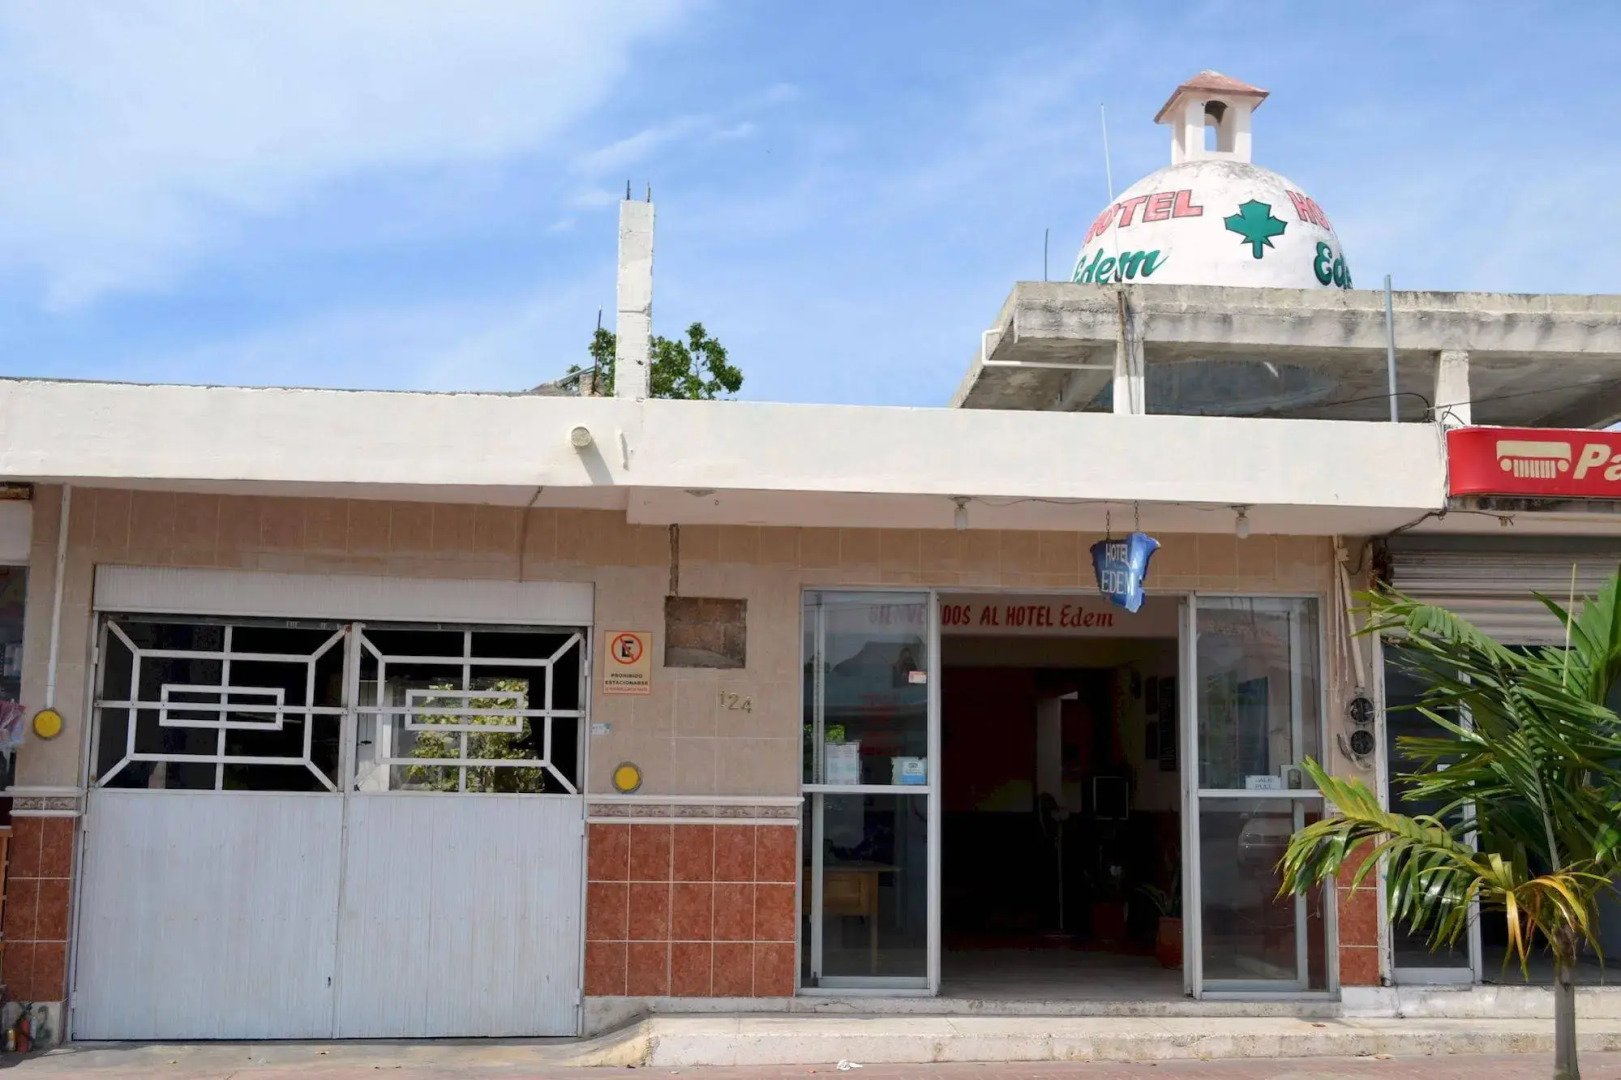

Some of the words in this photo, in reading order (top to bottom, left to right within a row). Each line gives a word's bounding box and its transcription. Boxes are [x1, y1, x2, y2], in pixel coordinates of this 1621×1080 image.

[1105, 543, 1132, 569] HOTEL
[979, 604, 999, 627] AL
[1006, 605, 1054, 628] HOTEL
[1060, 604, 1114, 628] Edem
